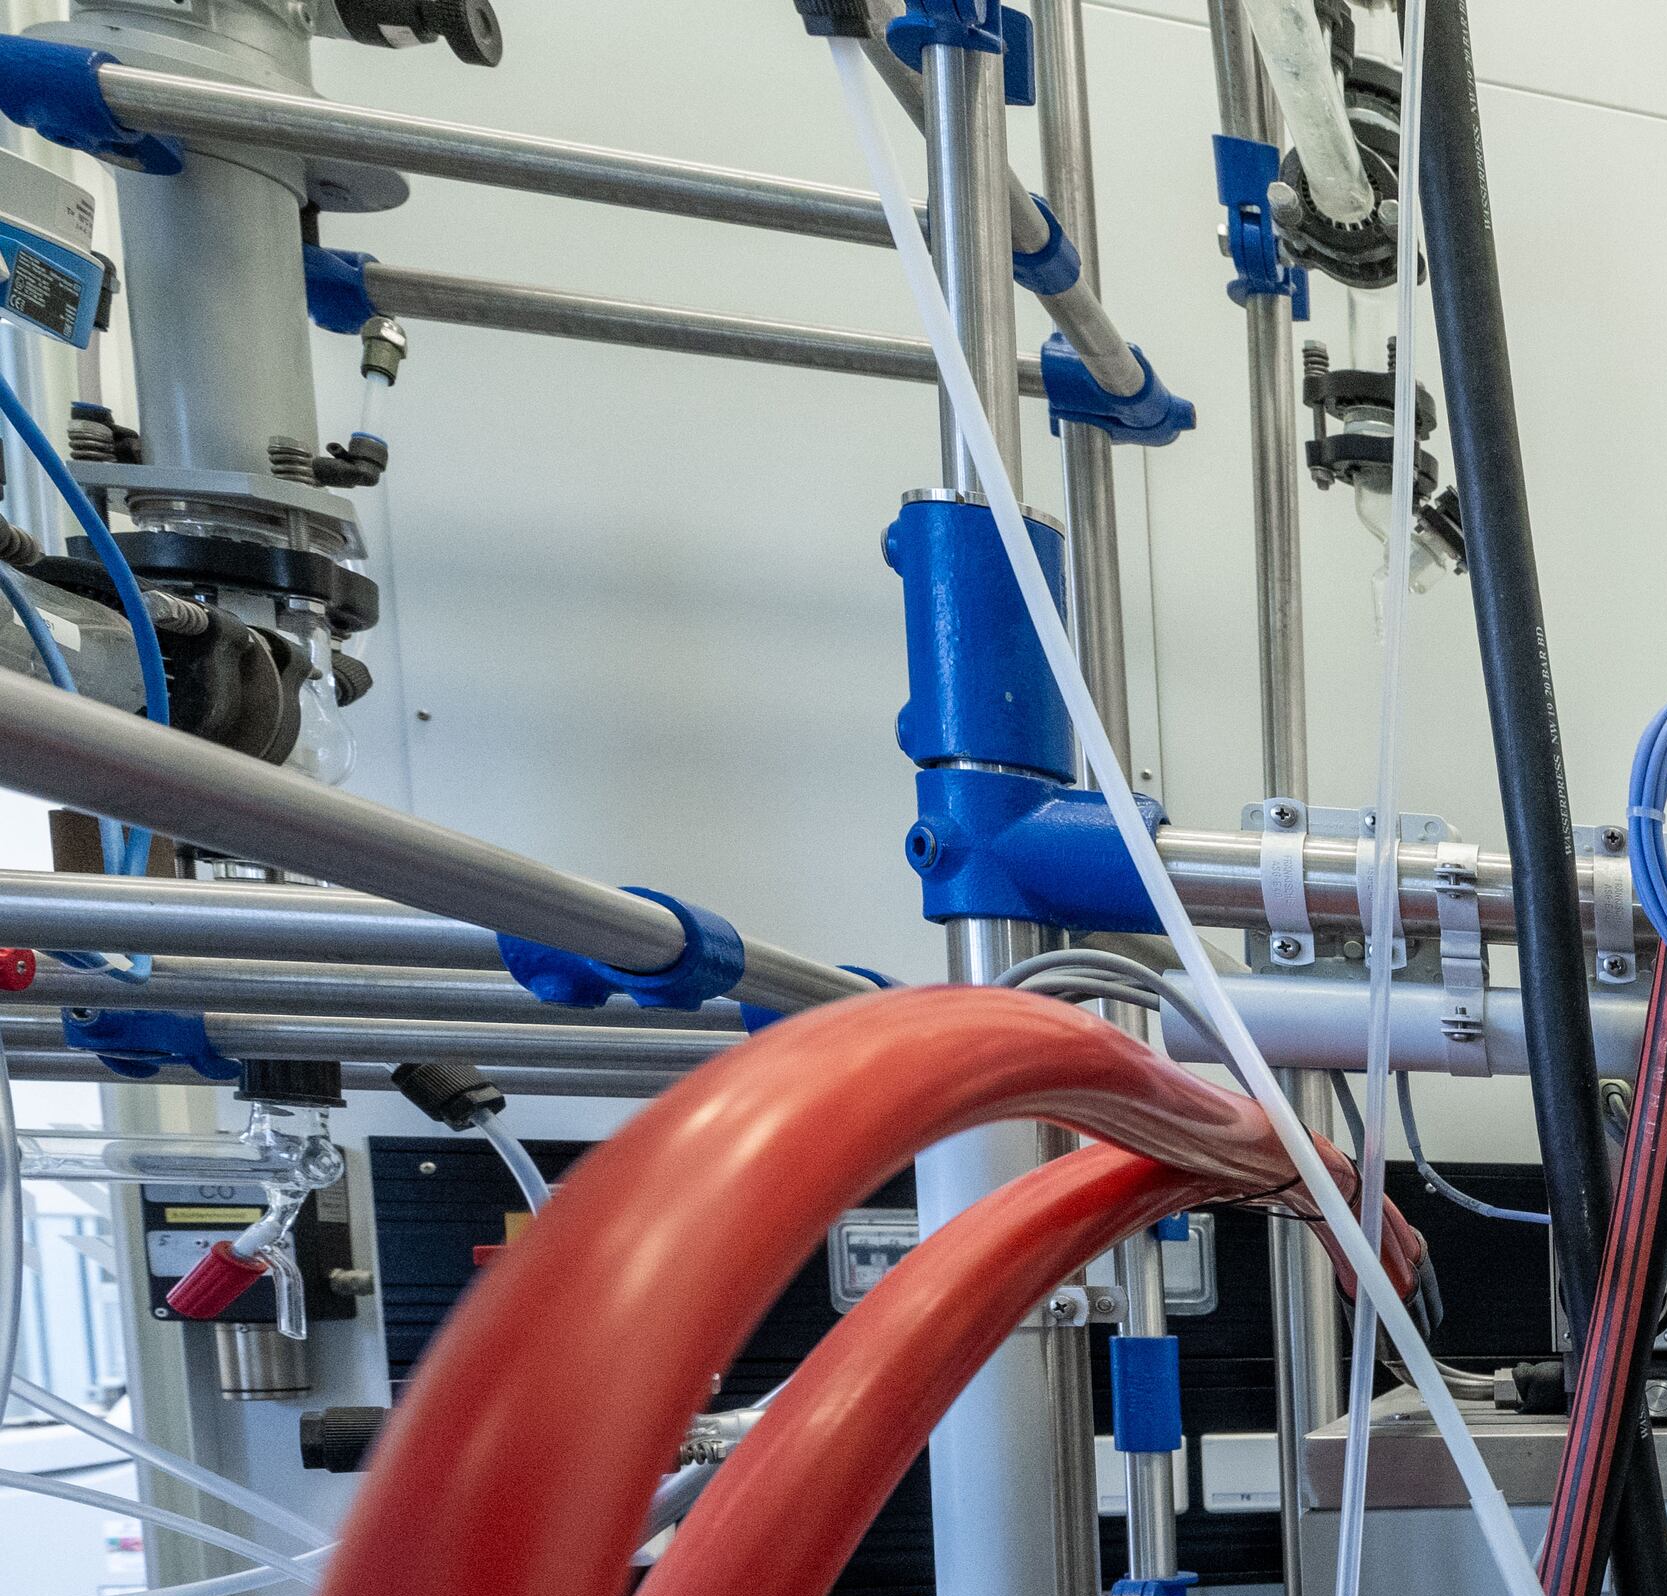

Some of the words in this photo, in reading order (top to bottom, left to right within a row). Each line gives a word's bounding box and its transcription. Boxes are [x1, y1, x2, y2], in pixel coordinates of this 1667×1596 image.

[1536, 626, 1546, 647] BD
[1538, 650, 1550, 679] BAR
[1544, 682, 1553, 697] 20
[1547, 702, 1555, 718] 19
[1549, 720, 1560, 745] NW
[1553, 754, 1573, 856] WASSERPRESS
